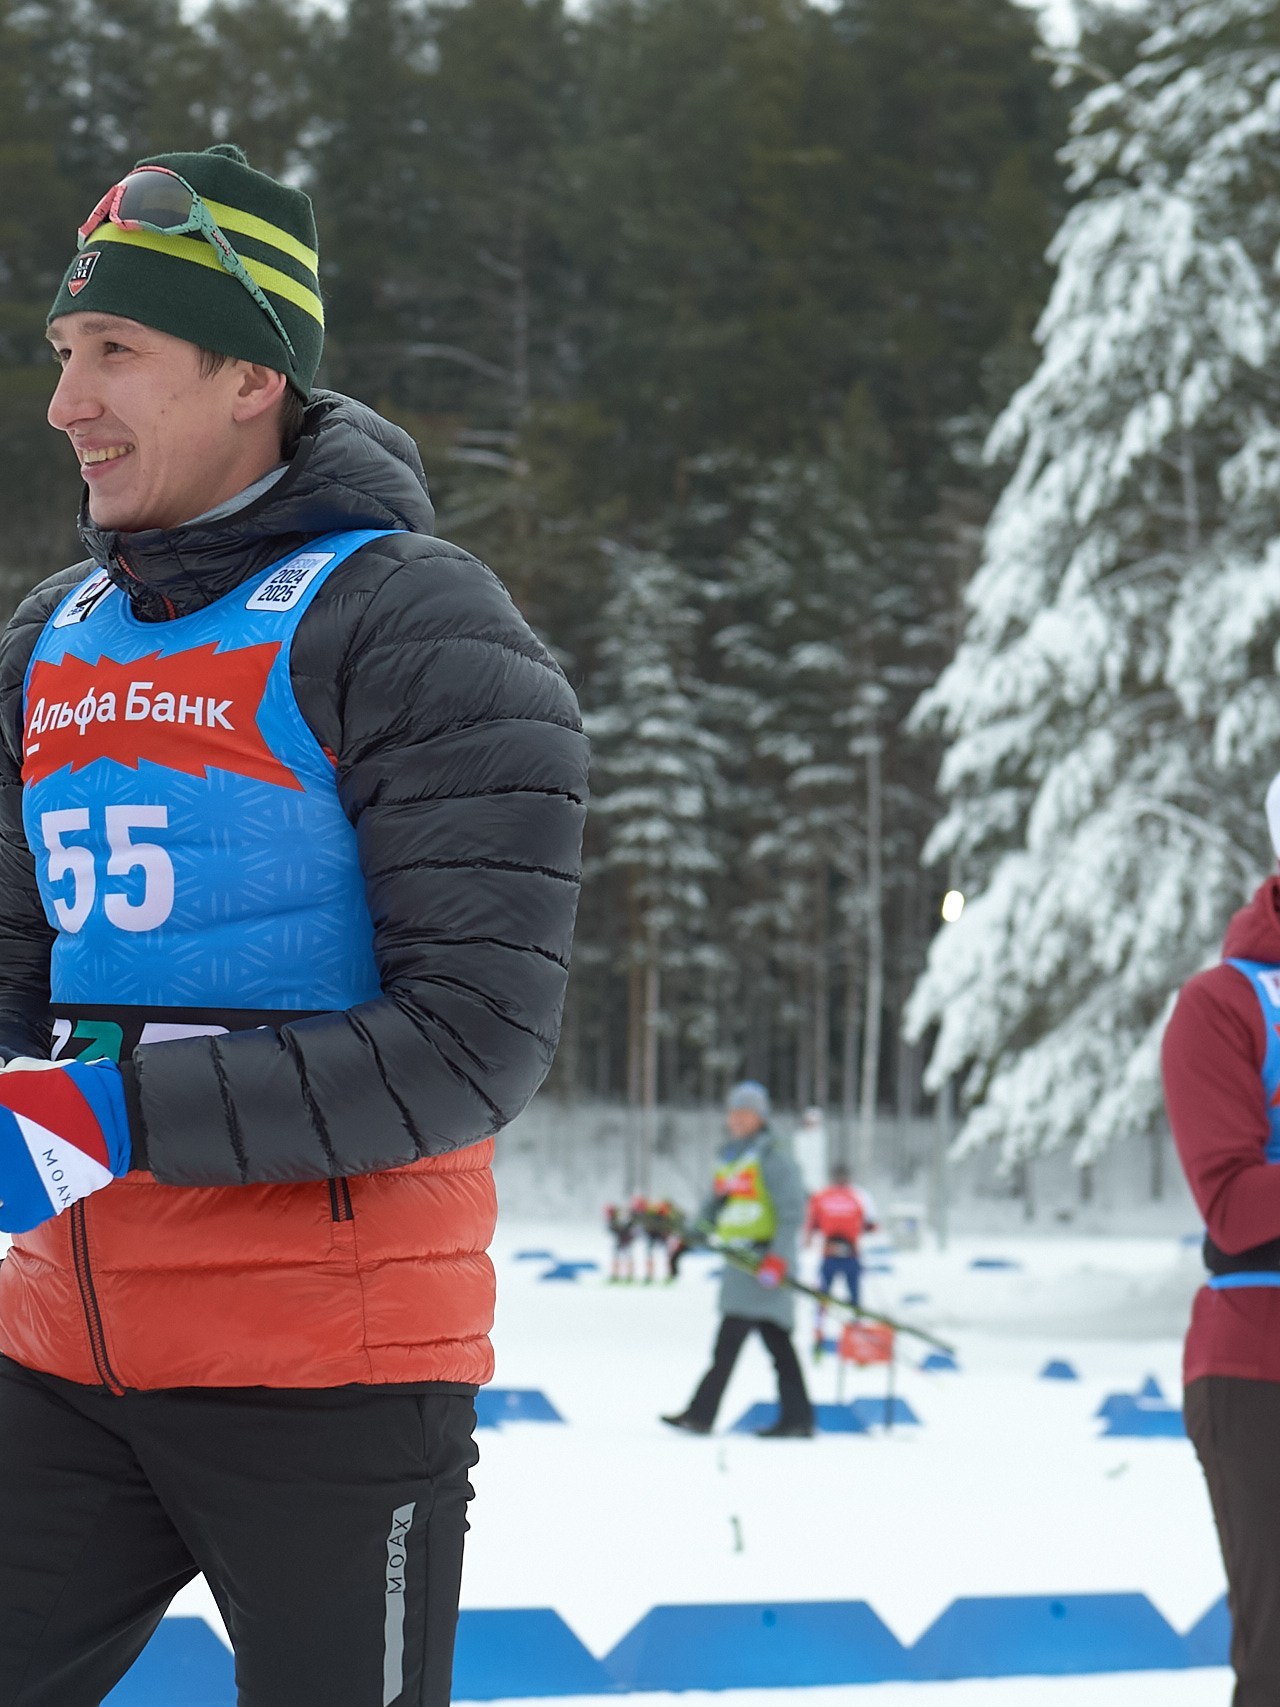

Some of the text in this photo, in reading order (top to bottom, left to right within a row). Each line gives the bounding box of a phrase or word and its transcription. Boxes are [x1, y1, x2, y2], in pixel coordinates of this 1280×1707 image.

[257, 585, 297, 602] 2025
[271, 568, 310, 584] 2024
[27, 682, 235, 736] Альфа Банк
[41, 804, 175, 933] 55
[42, 1148, 72, 1206] MOAX
[387, 1518, 410, 1594] MOAX
